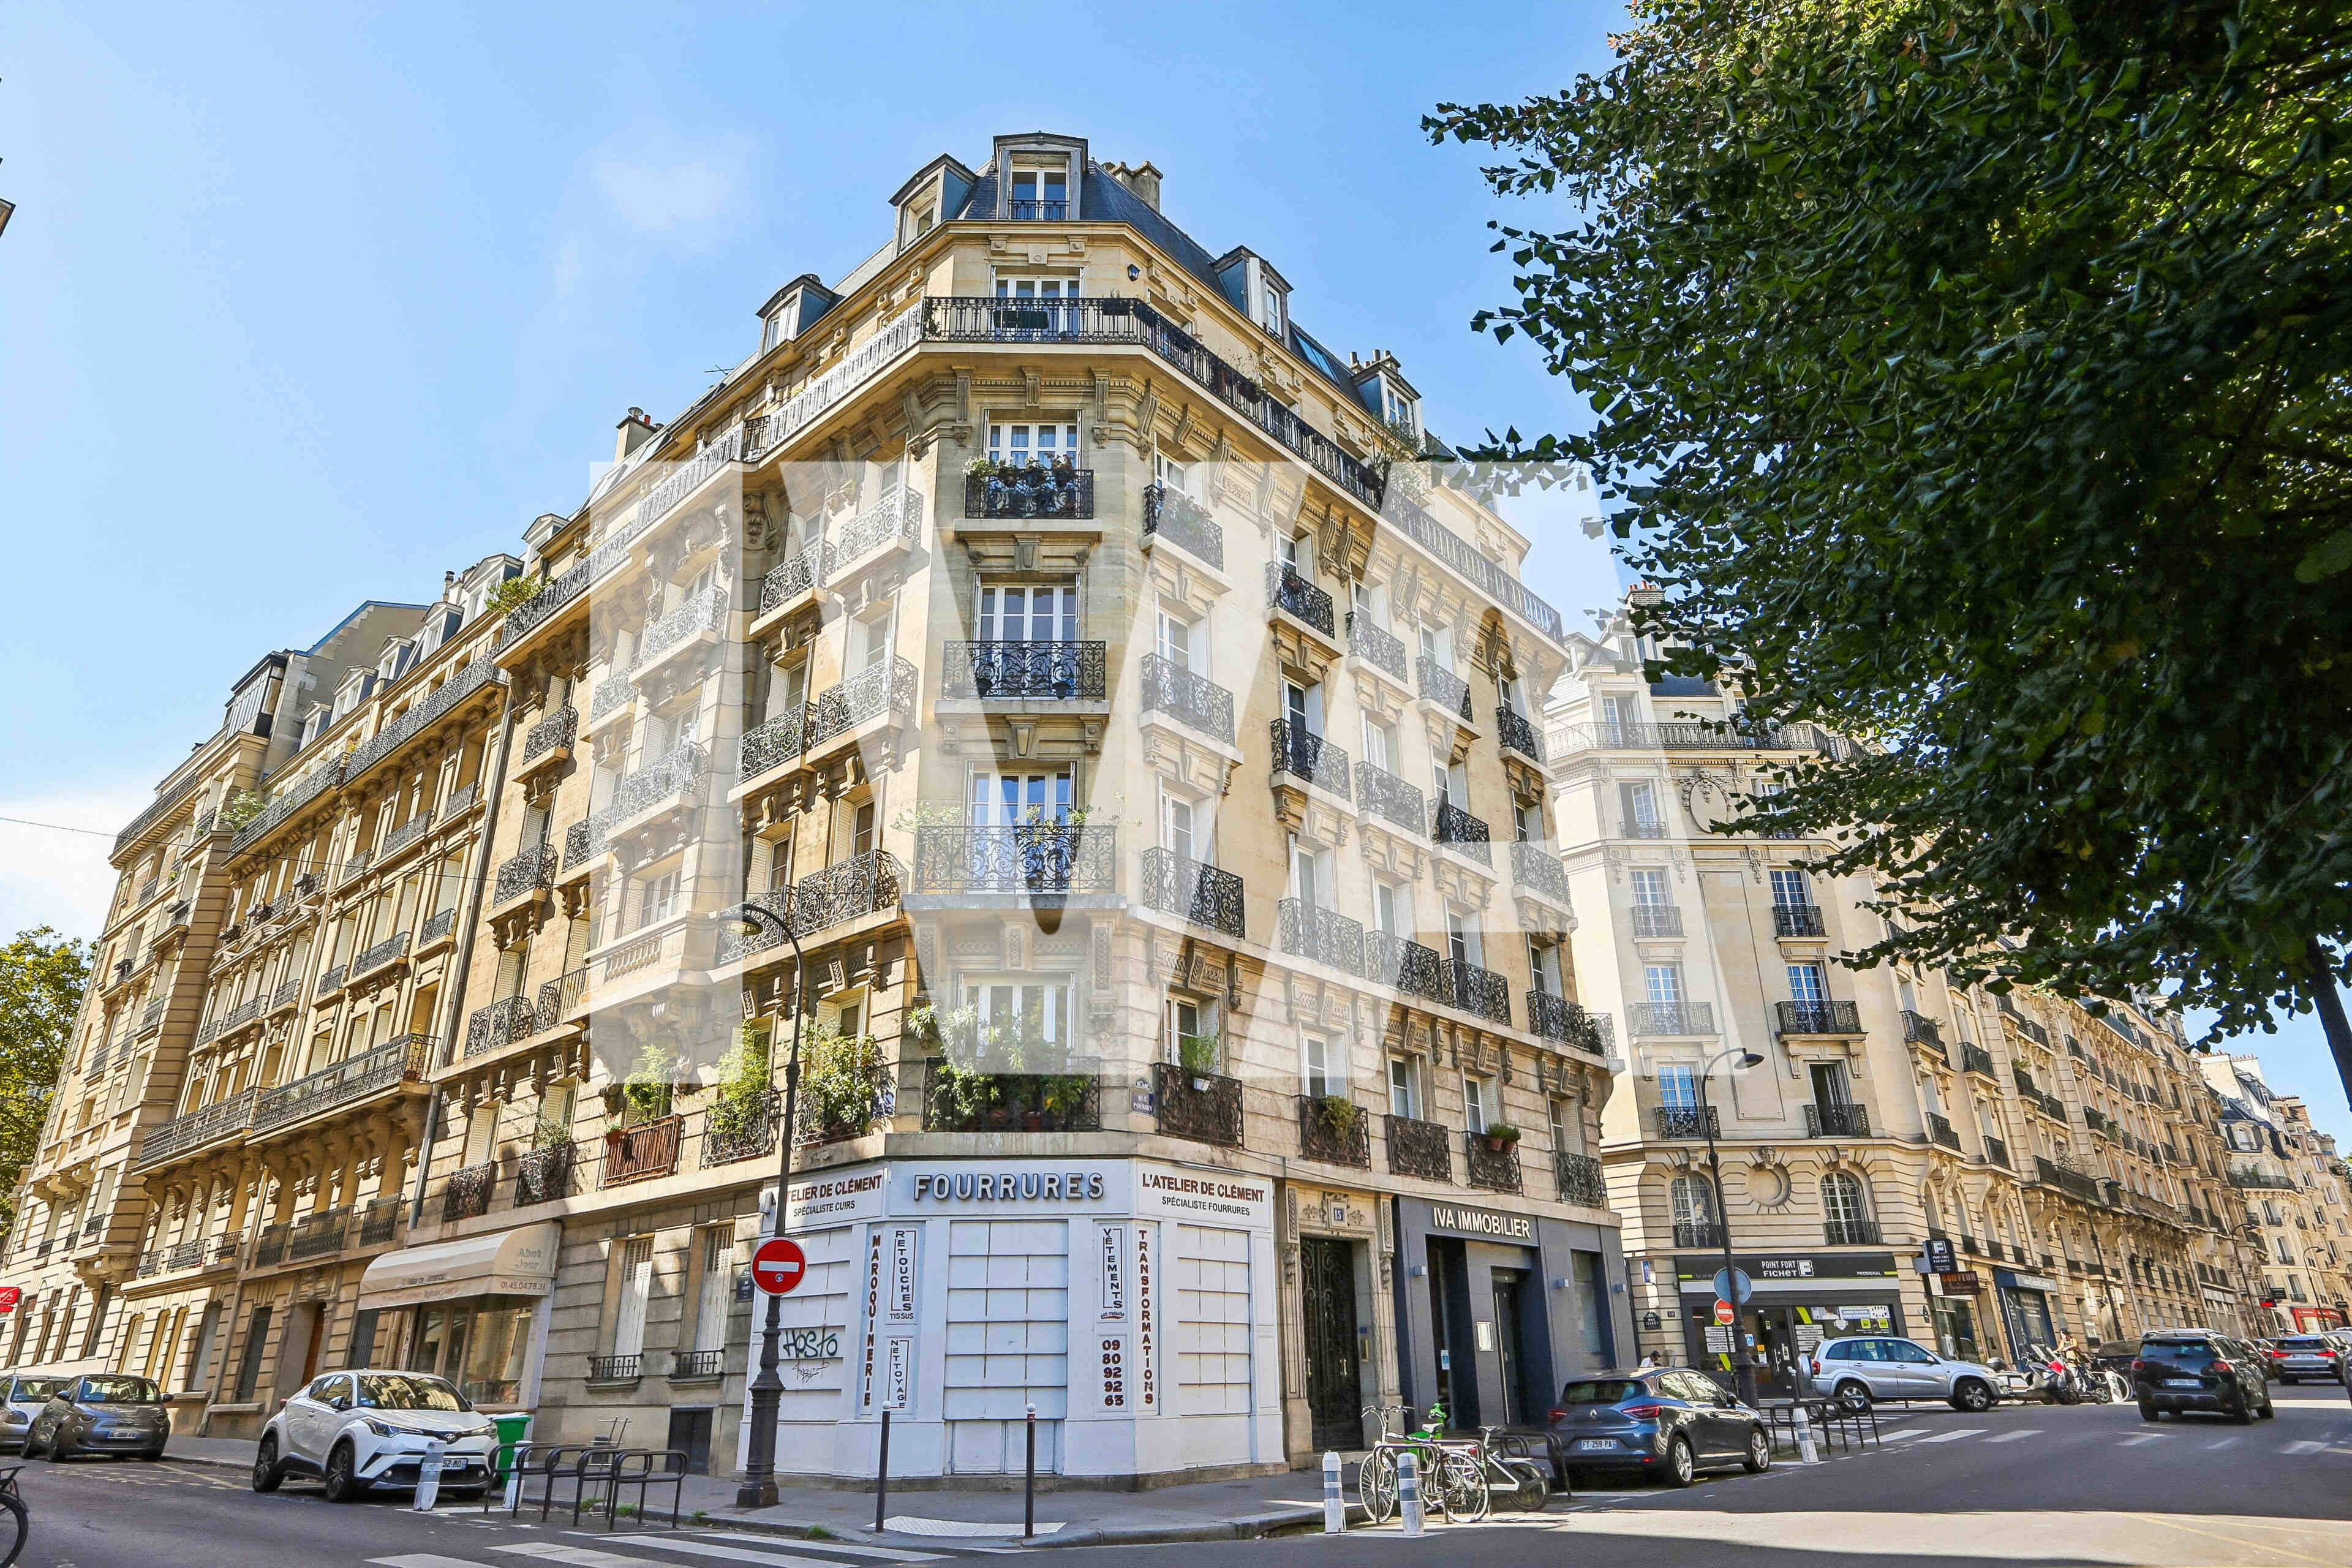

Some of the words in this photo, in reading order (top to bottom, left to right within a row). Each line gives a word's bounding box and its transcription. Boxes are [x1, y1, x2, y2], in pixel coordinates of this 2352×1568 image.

[820, 1183, 833, 1198] DE
[835, 1175, 883, 1196] CLÉMENT
[913, 1172, 1104, 1200] FOURRURES
[1142, 1173, 1199, 1194] L'ATELIER
[1200, 1182, 1215, 1196] DE
[1217, 1184, 1265, 1202] CLÉMENT
[793, 1203, 834, 1217] SPÉCIALISTE
[835, 1200, 855, 1211] CUIRS
[1161, 1196, 1207, 1210] SPÉCIALISTE
[1208, 1202, 1250, 1216] FOURRURES
[1433, 1207, 1456, 1229] IVA
[1458, 1210, 1531, 1238] IMMOBILIER
[895, 1231, 912, 1311] RETOUCHES
[1103, 1228, 1123, 1309] VÊTEMENTS
[864, 1235, 881, 1406] MAROQUINERIE
[1139, 1230, 1153, 1404] TRANSFORMATIONS
[1102, 1340, 1120, 1351] 09
[1102, 1353, 1121, 1365] 80
[891, 1340, 906, 1409] NETTOYAGE
[1103, 1366, 1122, 1378] 92
[1104, 1381, 1123, 1392] 92
[1104, 1394, 1124, 1406] 63
